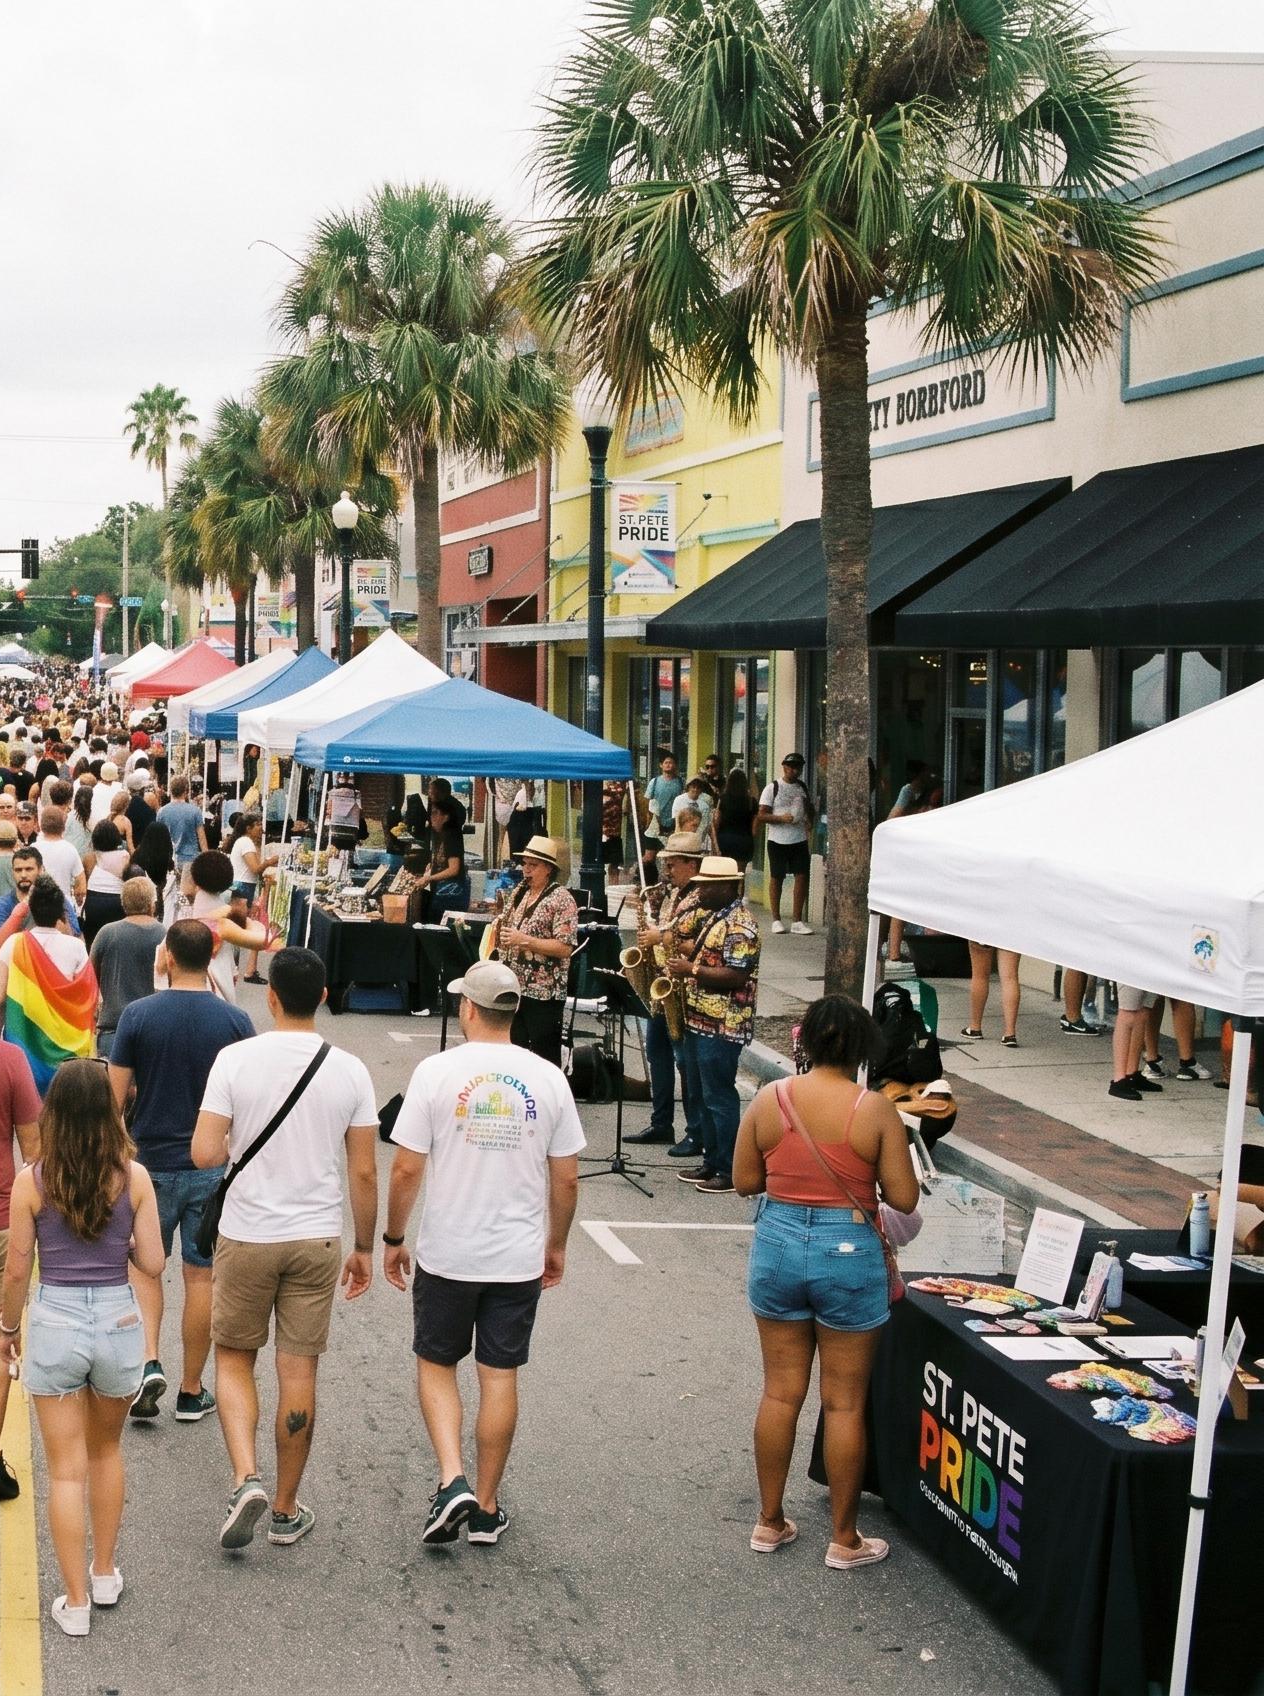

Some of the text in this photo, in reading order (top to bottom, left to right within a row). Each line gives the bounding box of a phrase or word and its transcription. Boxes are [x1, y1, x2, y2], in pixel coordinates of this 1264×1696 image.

[619, 514, 669, 526] ST. PETE
[619, 527, 669, 541] PRIDE
[923, 1361, 1027, 1486] ST. PETE
[919, 1408, 1024, 1561] PRIDE
